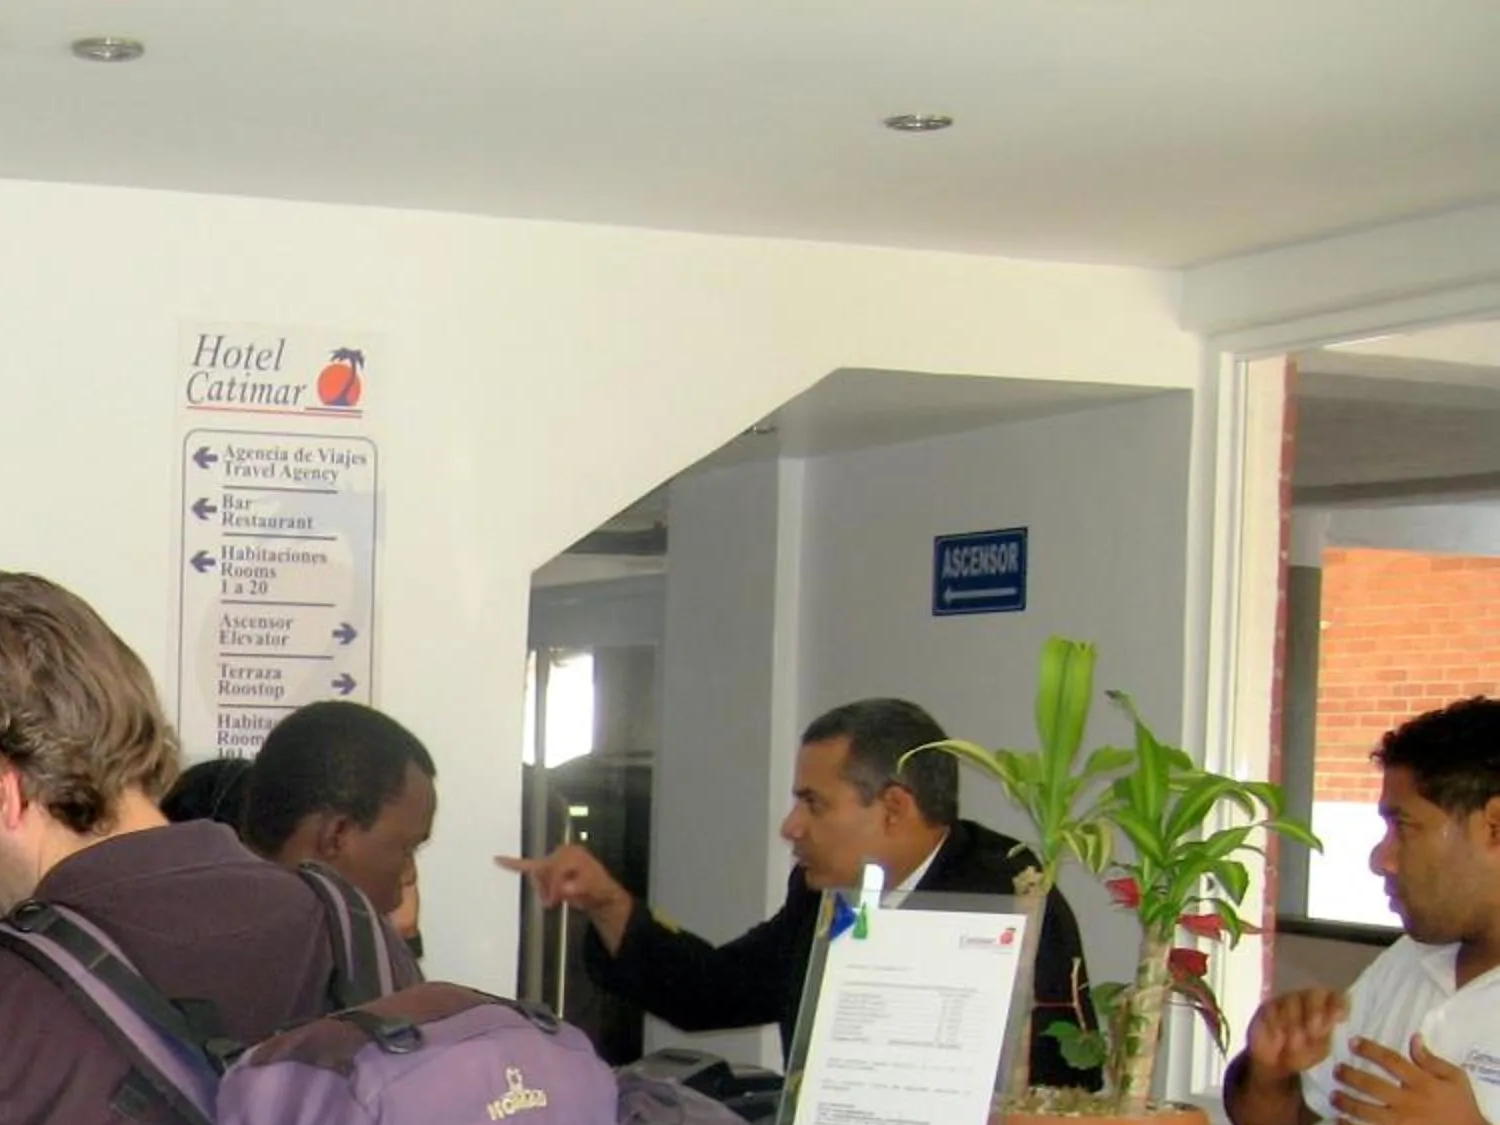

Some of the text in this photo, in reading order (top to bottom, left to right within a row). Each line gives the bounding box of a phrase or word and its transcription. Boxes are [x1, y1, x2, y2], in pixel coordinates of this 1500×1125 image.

[193, 333, 286, 372] Hotel
[186, 370, 307, 406] Catimar
[223, 444, 367, 469] Agencia de Viajes
[223, 462, 339, 484] Travel Agency
[222, 494, 252, 509] Bar
[221, 511, 313, 530] Restaurant
[221, 545, 328, 564] Habitaciones
[942, 541, 1019, 579] ASCENSOR
[221, 564, 277, 578] Rooms
[221, 580, 269, 595] 1 a 20
[220, 613, 293, 630] Ascensor
[219, 629, 290, 646] Elevator
[220, 663, 283, 680] Terraza
[216, 730, 268, 746] Room
